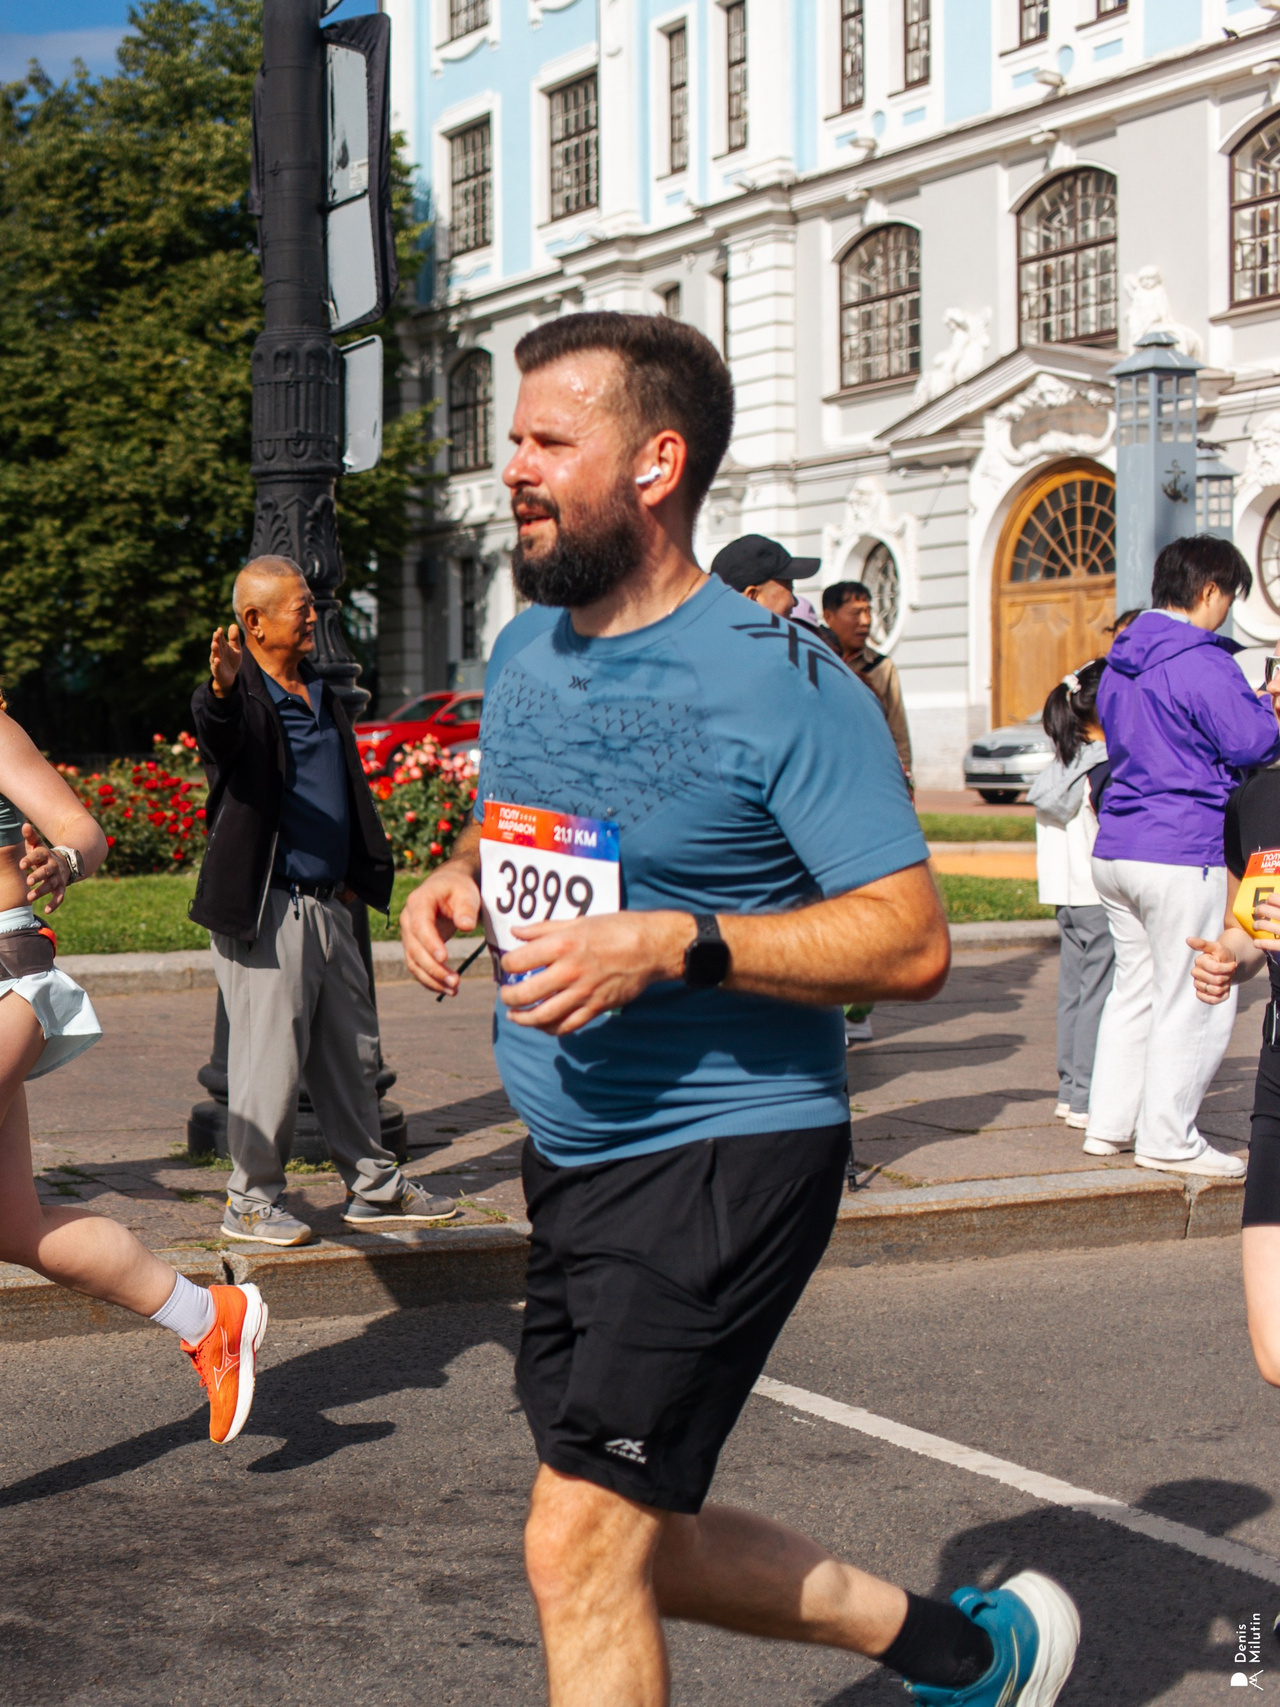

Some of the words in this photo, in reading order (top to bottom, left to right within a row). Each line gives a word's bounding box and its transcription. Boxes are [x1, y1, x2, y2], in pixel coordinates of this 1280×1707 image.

[500, 807, 519, 820] ПОЛУ
[498, 819, 536, 835] МАРАФОН
[574, 829, 597, 848] КМ
[496, 860, 593, 920] 3899
